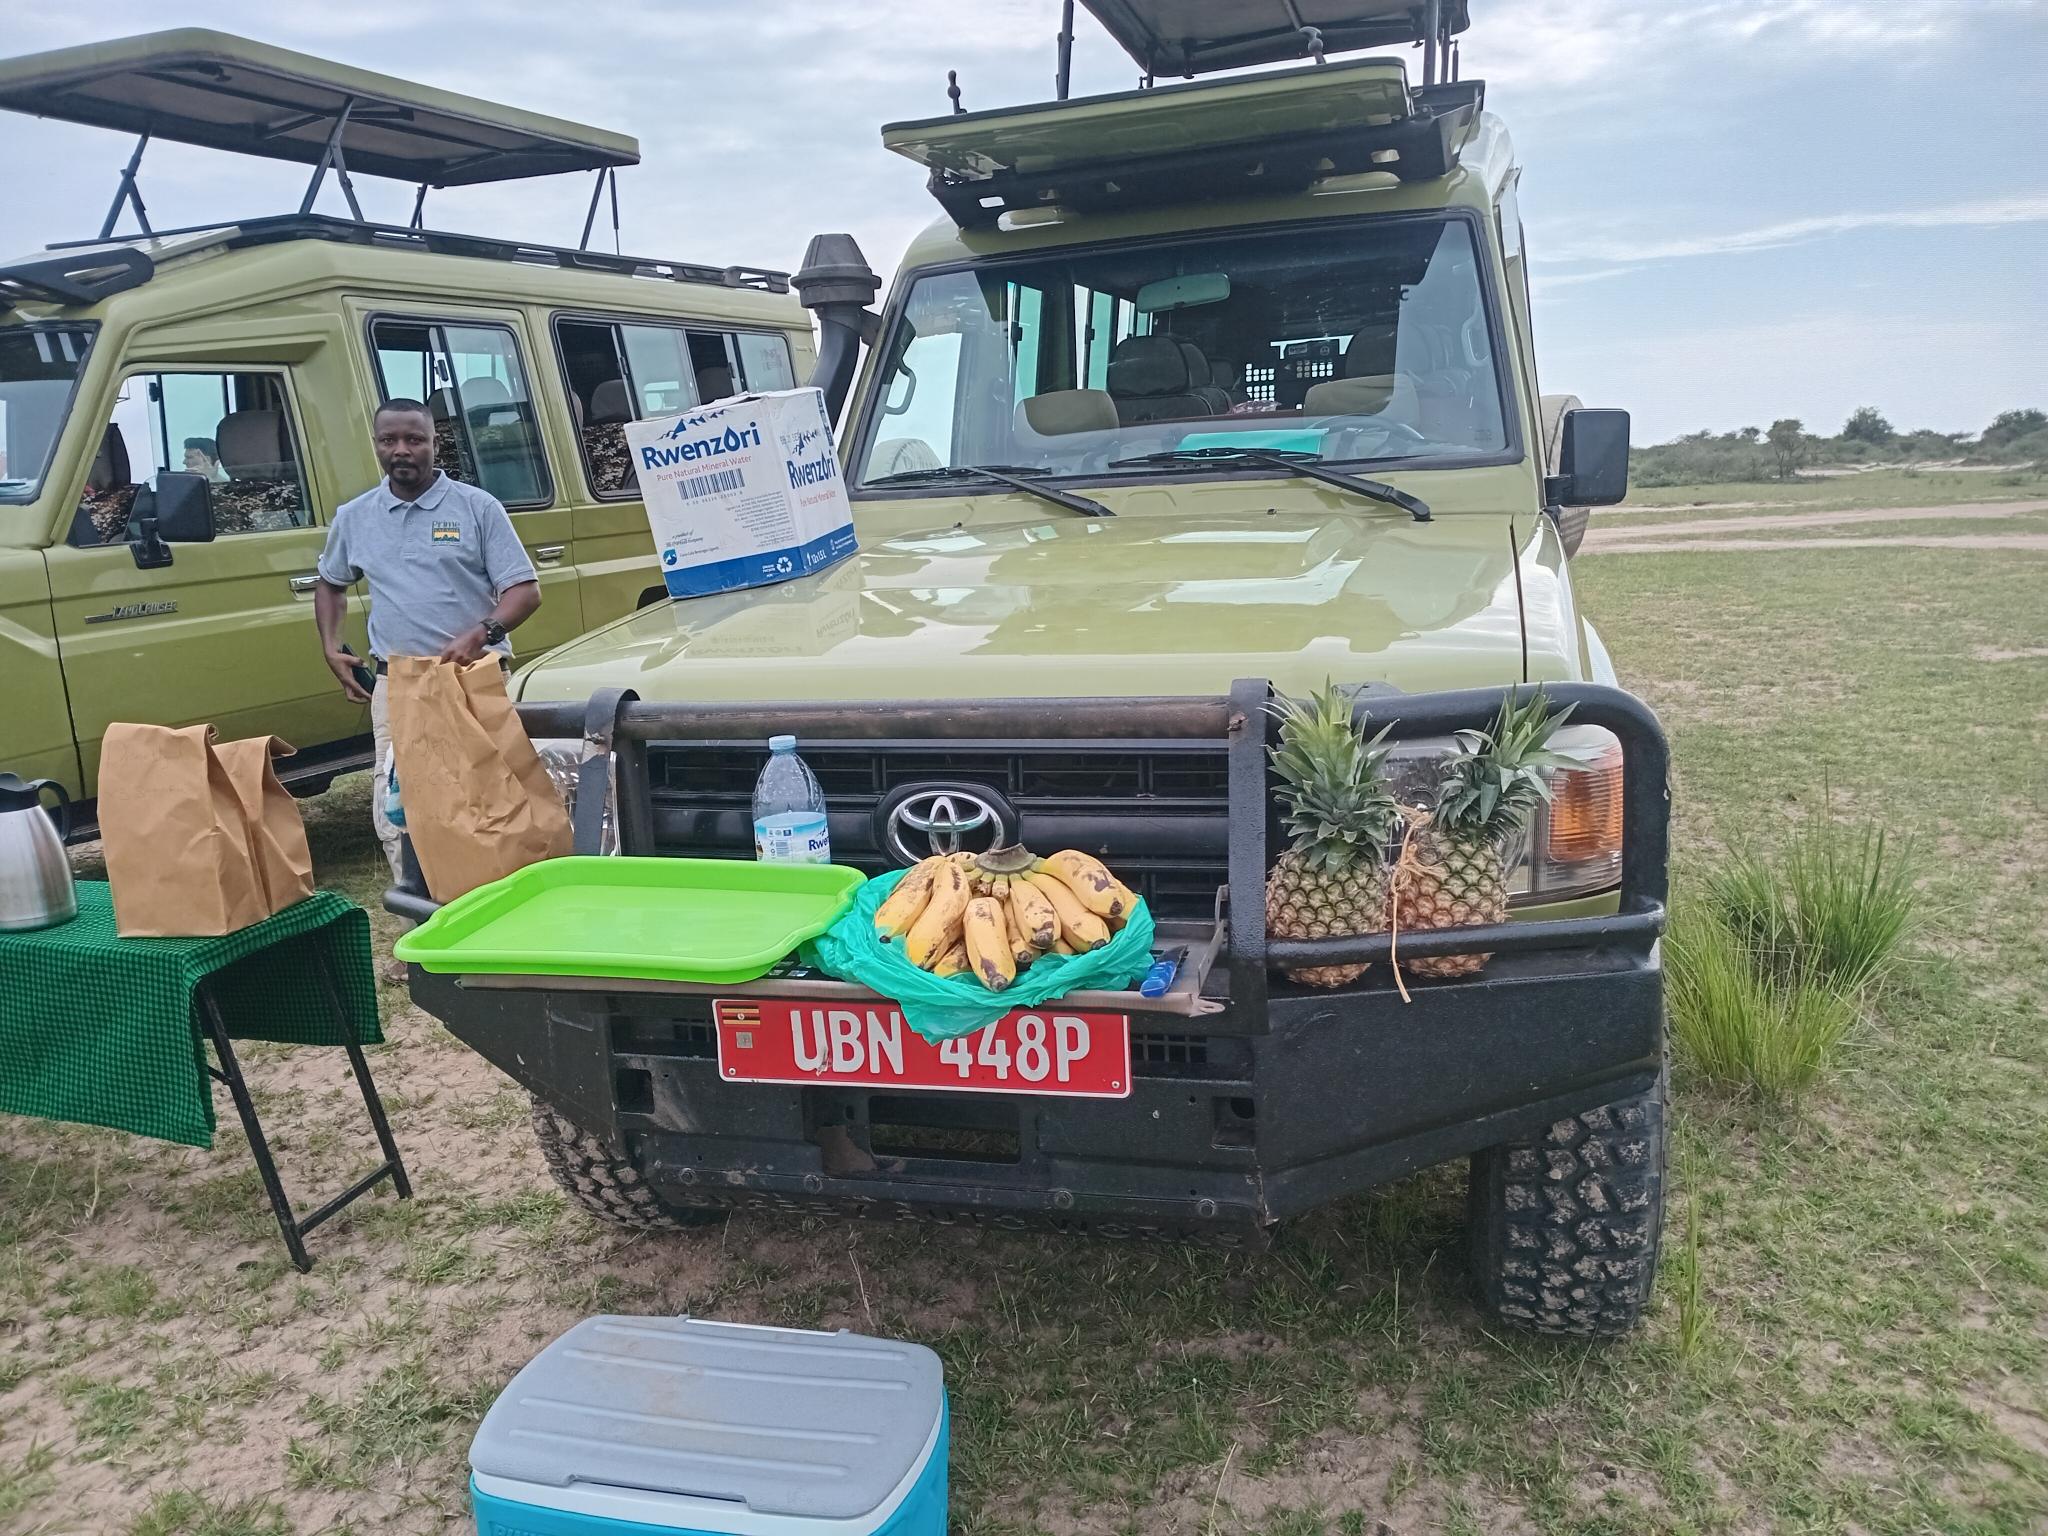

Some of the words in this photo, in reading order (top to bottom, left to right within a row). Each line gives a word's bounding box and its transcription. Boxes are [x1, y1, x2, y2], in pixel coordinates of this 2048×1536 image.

[641, 421, 761, 470] Rwenzori
[656, 472, 673, 481] Pure
[673, 464, 701, 479] Natural
[701, 460, 729, 473] Mineral
[728, 455, 752, 467] Water
[786, 449, 837, 490] Rwenzori
[808, 837, 831, 851] Rwe
[790, 1010, 904, 1076] UBN
[938, 1013, 1091, 1083] 448P
[895, 1201, 1025, 1230] AUTO
[1050, 1216, 1245, 1249] WORKS
